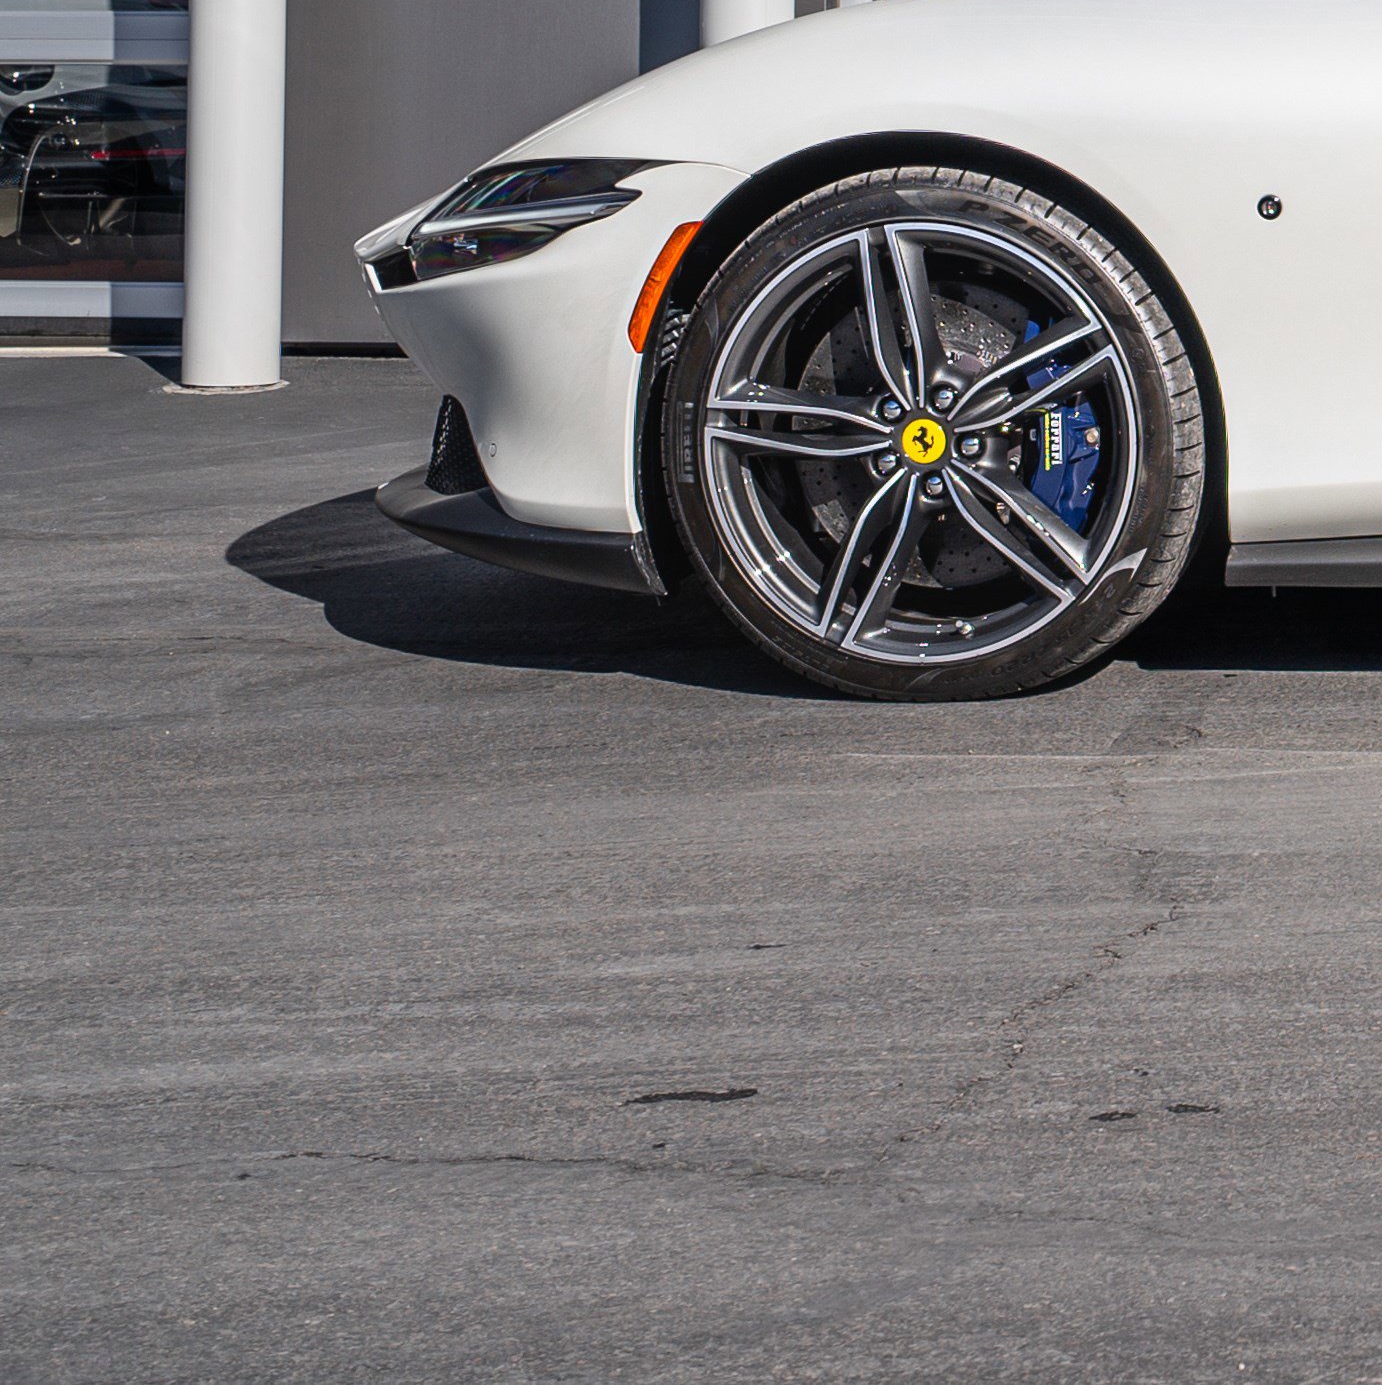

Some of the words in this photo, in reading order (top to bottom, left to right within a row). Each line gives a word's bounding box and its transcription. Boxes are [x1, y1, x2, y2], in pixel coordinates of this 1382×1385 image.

[958, 199, 990, 213] P
[994, 213, 1103, 285] ZERO
[1050, 411, 1063, 466] Ferrari
